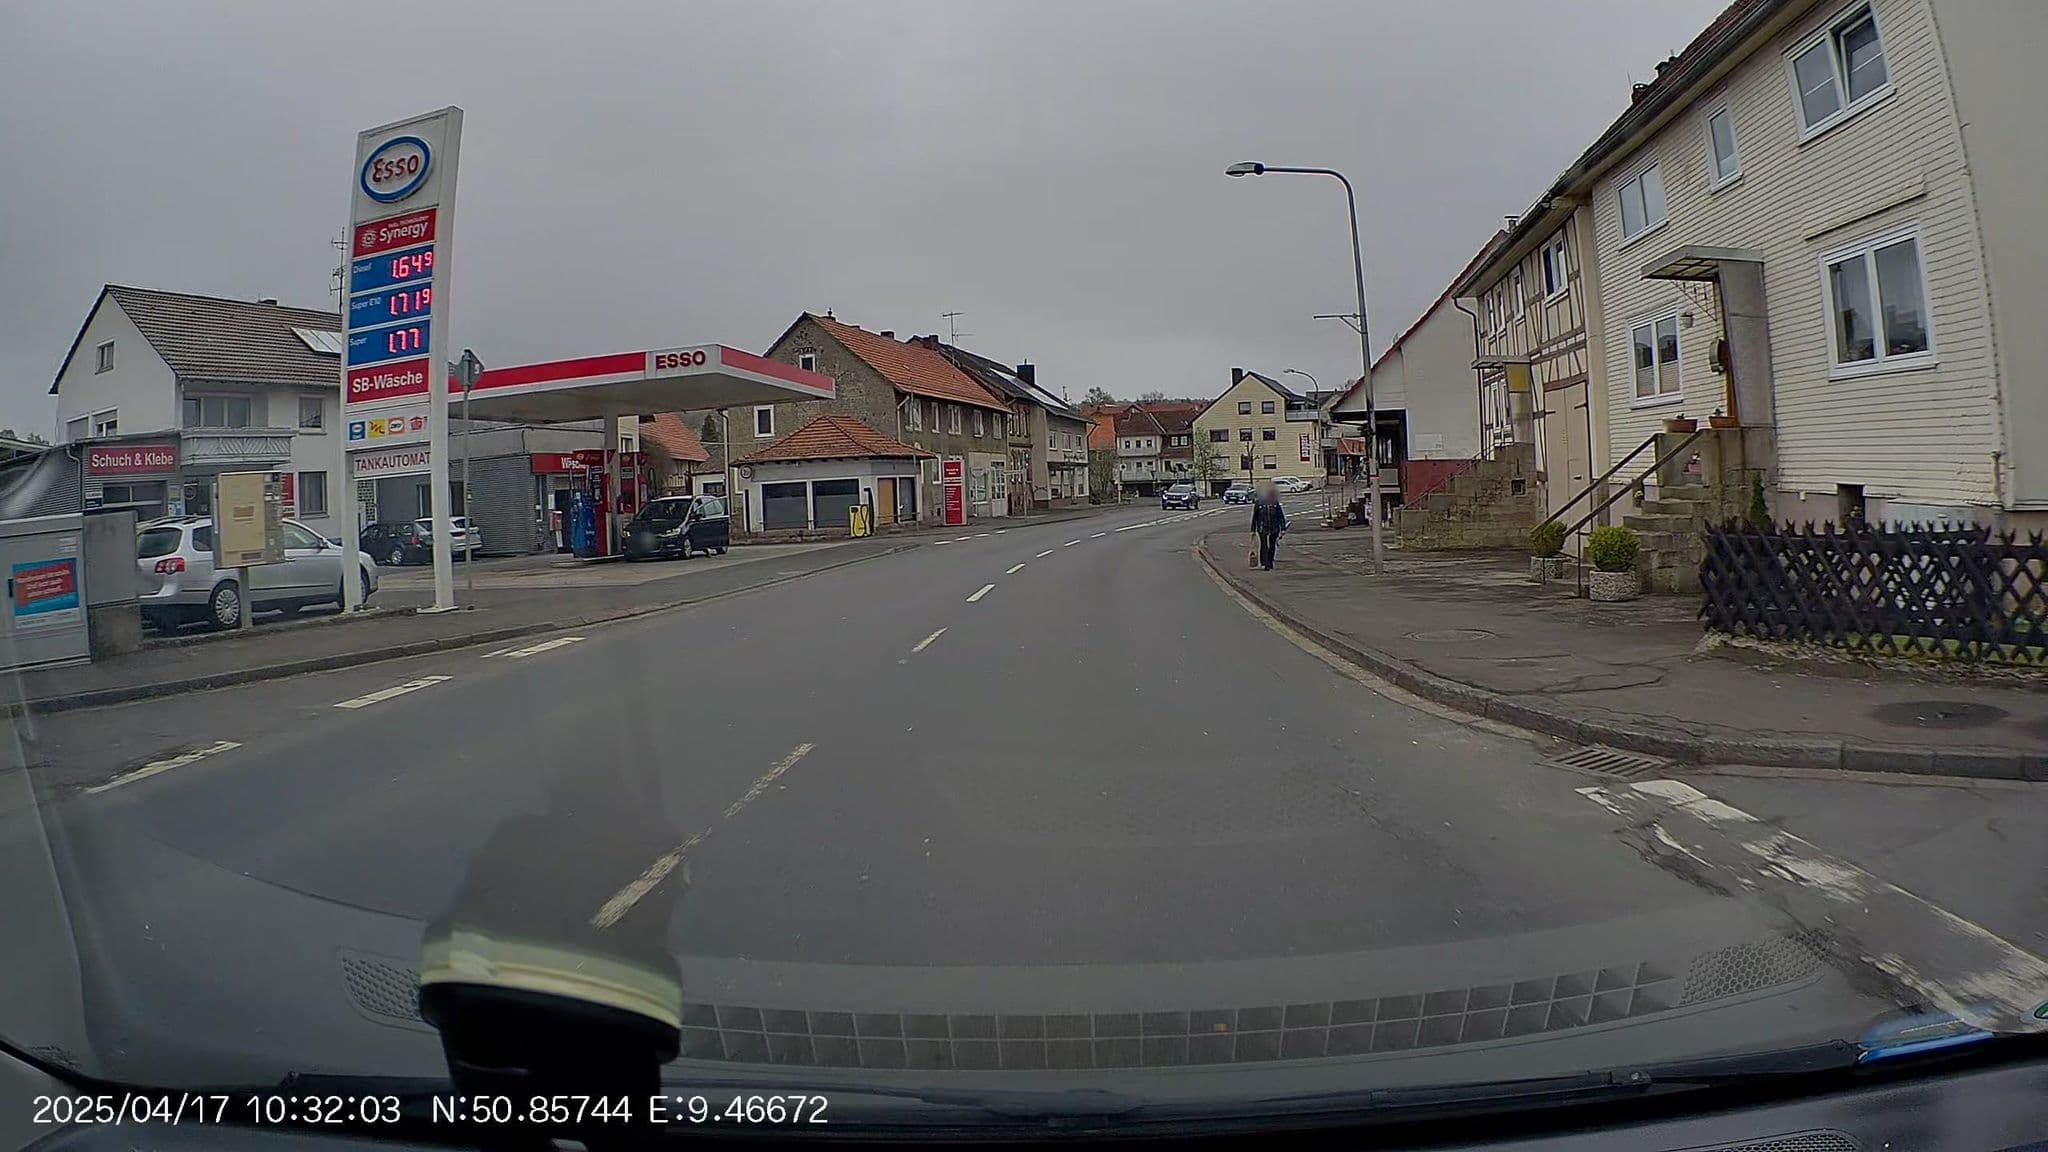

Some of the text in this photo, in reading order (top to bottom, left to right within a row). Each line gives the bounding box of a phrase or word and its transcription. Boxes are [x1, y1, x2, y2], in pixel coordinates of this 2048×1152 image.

[379, 222, 428, 243] Synergy
[656, 350, 706, 370] ESSO
[352, 371, 423, 393] SB-Wäsche
[91, 452, 174, 468] Schuch & Klebe
[355, 451, 431, 472] TANKAUTOMAT
